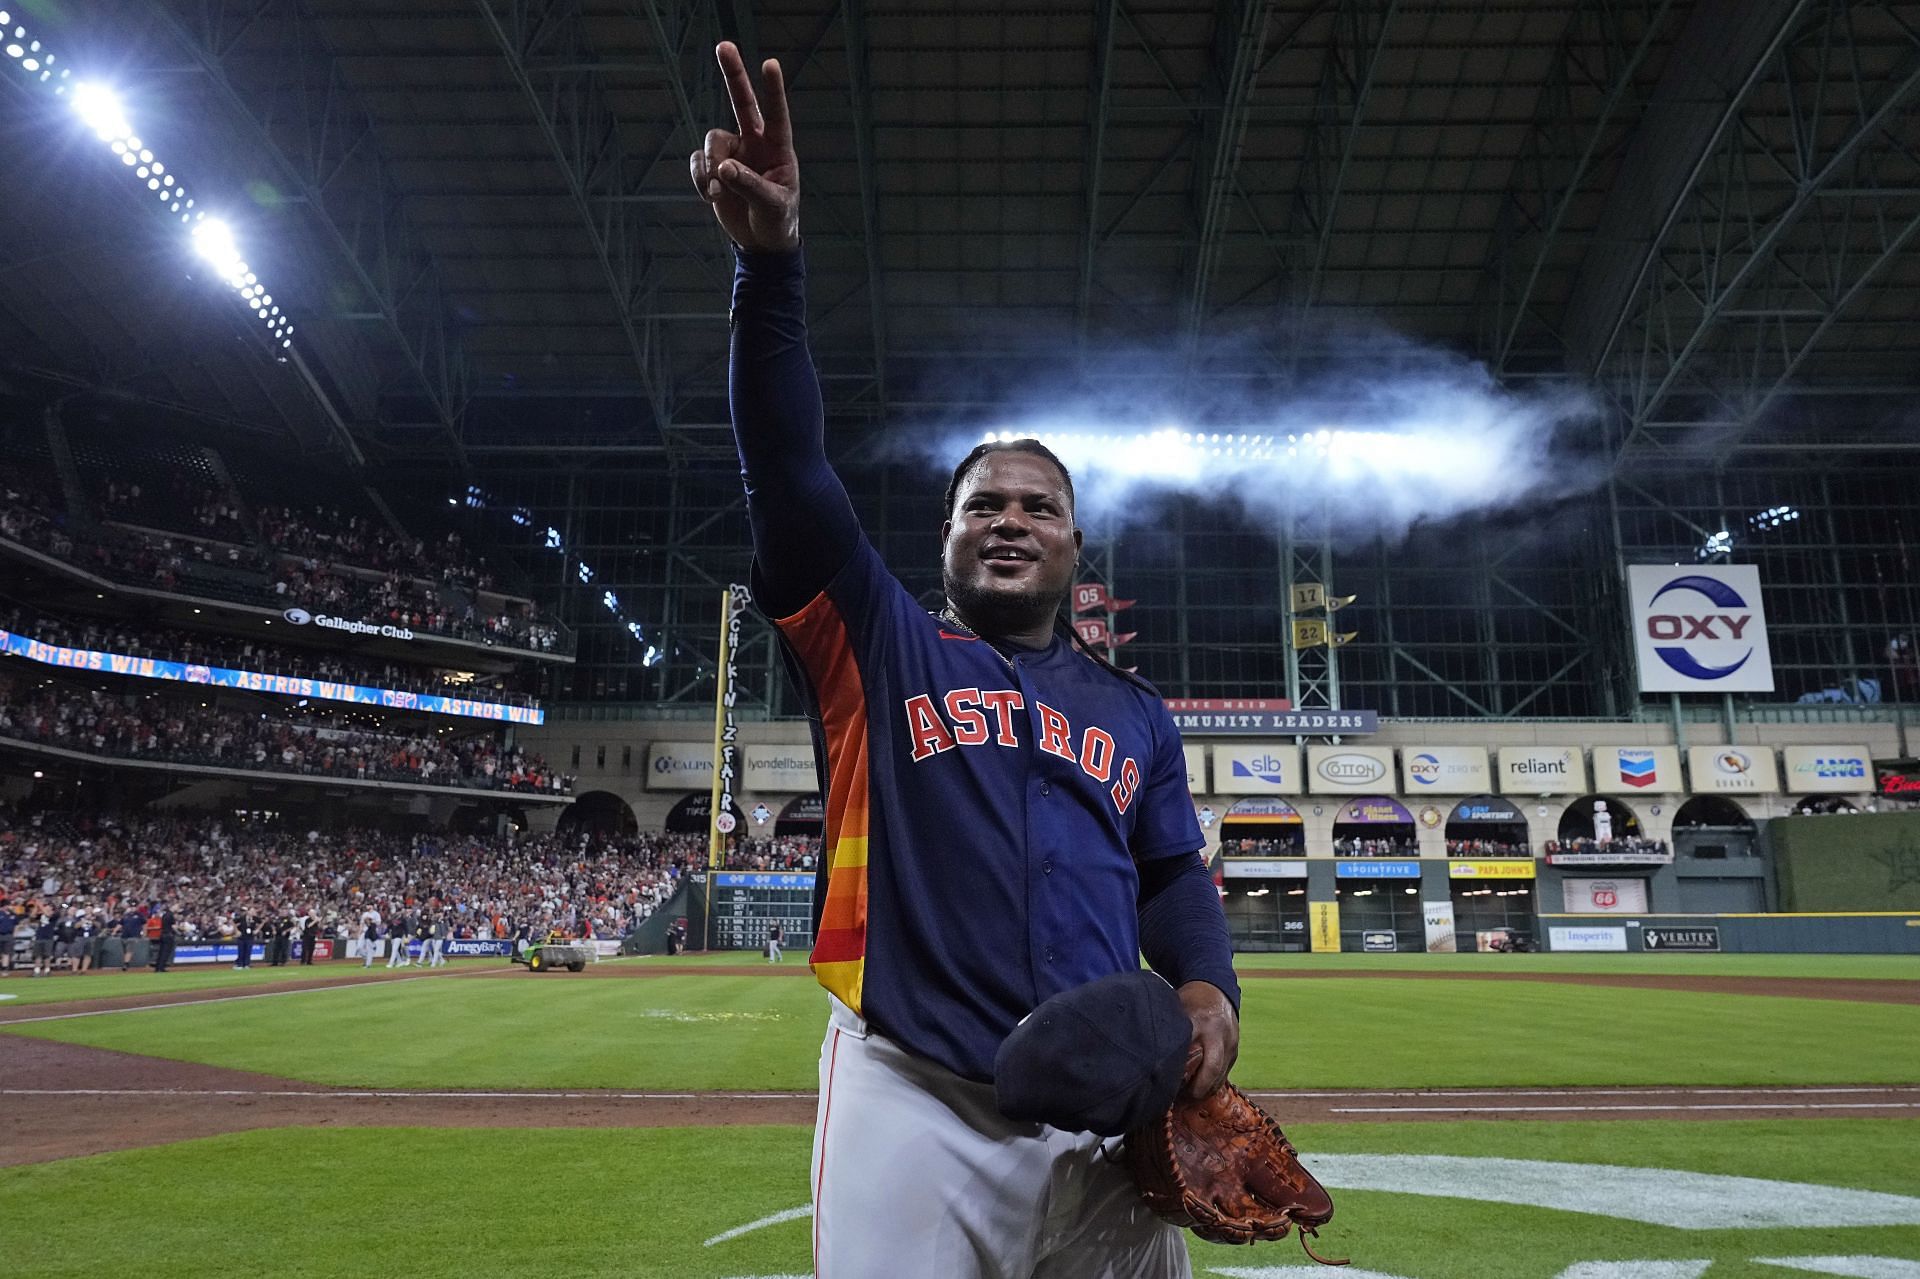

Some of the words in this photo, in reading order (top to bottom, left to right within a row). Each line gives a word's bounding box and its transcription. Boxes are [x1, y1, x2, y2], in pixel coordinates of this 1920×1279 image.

[1079, 588, 1098, 604] 05
[1297, 589, 1316, 603] 17
[314, 614, 380, 634] Gallagher
[381, 625, 413, 640] Club
[1081, 625, 1099, 640] 19
[1300, 627, 1318, 640] 22
[1647, 615, 1752, 640] OXY
[27, 639, 103, 669] ASTROS
[111, 654, 155, 677] WIN
[236, 671, 312, 696] ASTROS
[319, 681, 355, 701] WIN
[440, 697, 501, 719] ASTROS
[508, 705, 539, 724] WIN
[1168, 701, 1210, 709] NUTE
[1224, 701, 1266, 709] MAID
[1273, 715, 1363, 728] LEADERS
[905, 687, 1140, 815] ASTROS
[1618, 749, 1654, 757] Chevron
[673, 759, 714, 770] CALPIN
[748, 756, 816, 770] lyondellbase
[1252, 755, 1281, 773] slb
[1326, 761, 1376, 778] COTTON
[1410, 765, 1440, 773] OXY
[1511, 759, 1567, 773] reliant
[1816, 758, 1865, 777] LNG
[721, 746, 734, 811] FAIR
[1716, 780, 1755, 788] QUANTA
[1363, 805, 1392, 816] planet
[1368, 813, 1399, 821] fitness
[1478, 866, 1499, 874] PAPA
[690, 874, 707, 883] 315
[1595, 893, 1615, 905] 66
[1568, 931, 1613, 942] Insperity
[1660, 932, 1714, 942] VERITEX
[448, 939, 504, 954] AmegyBank
